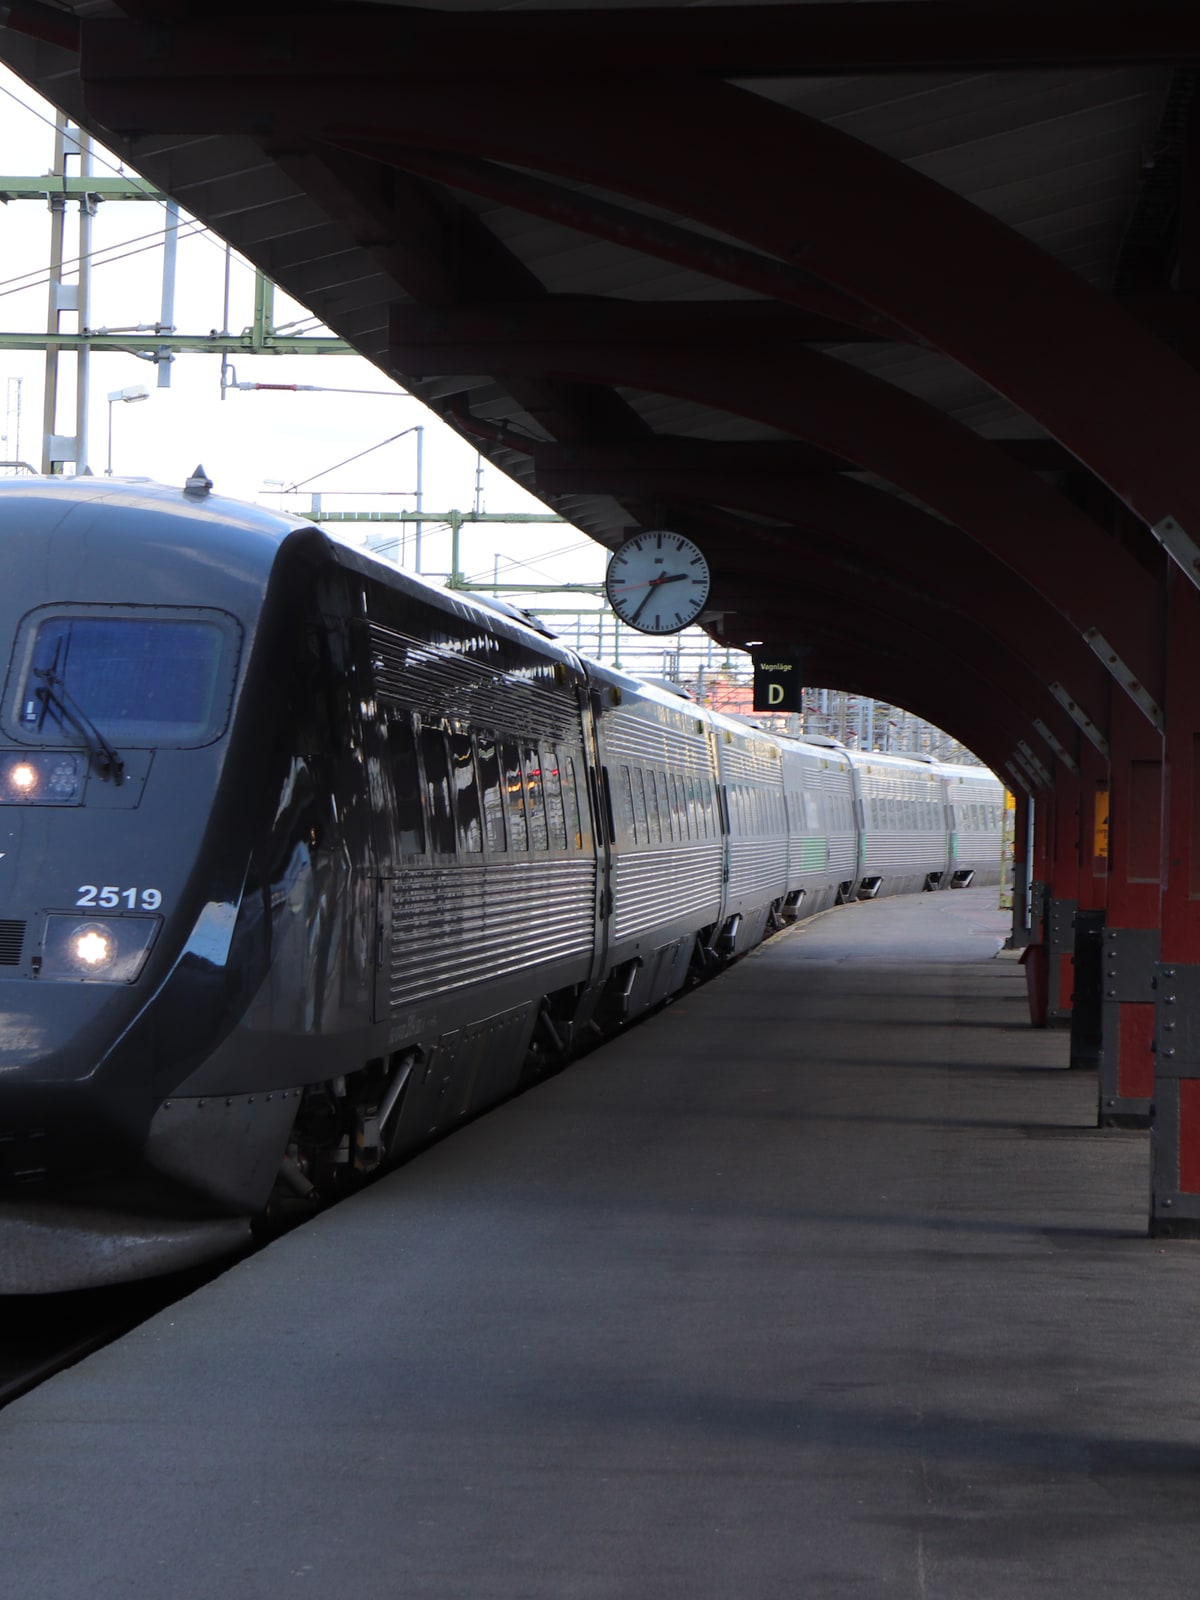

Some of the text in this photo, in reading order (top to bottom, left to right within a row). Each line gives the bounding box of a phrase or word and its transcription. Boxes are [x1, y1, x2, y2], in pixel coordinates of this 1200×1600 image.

[760, 663, 792, 672] Vagnläge
[769, 684, 784, 705] D
[75, 884, 162, 910] 2519
